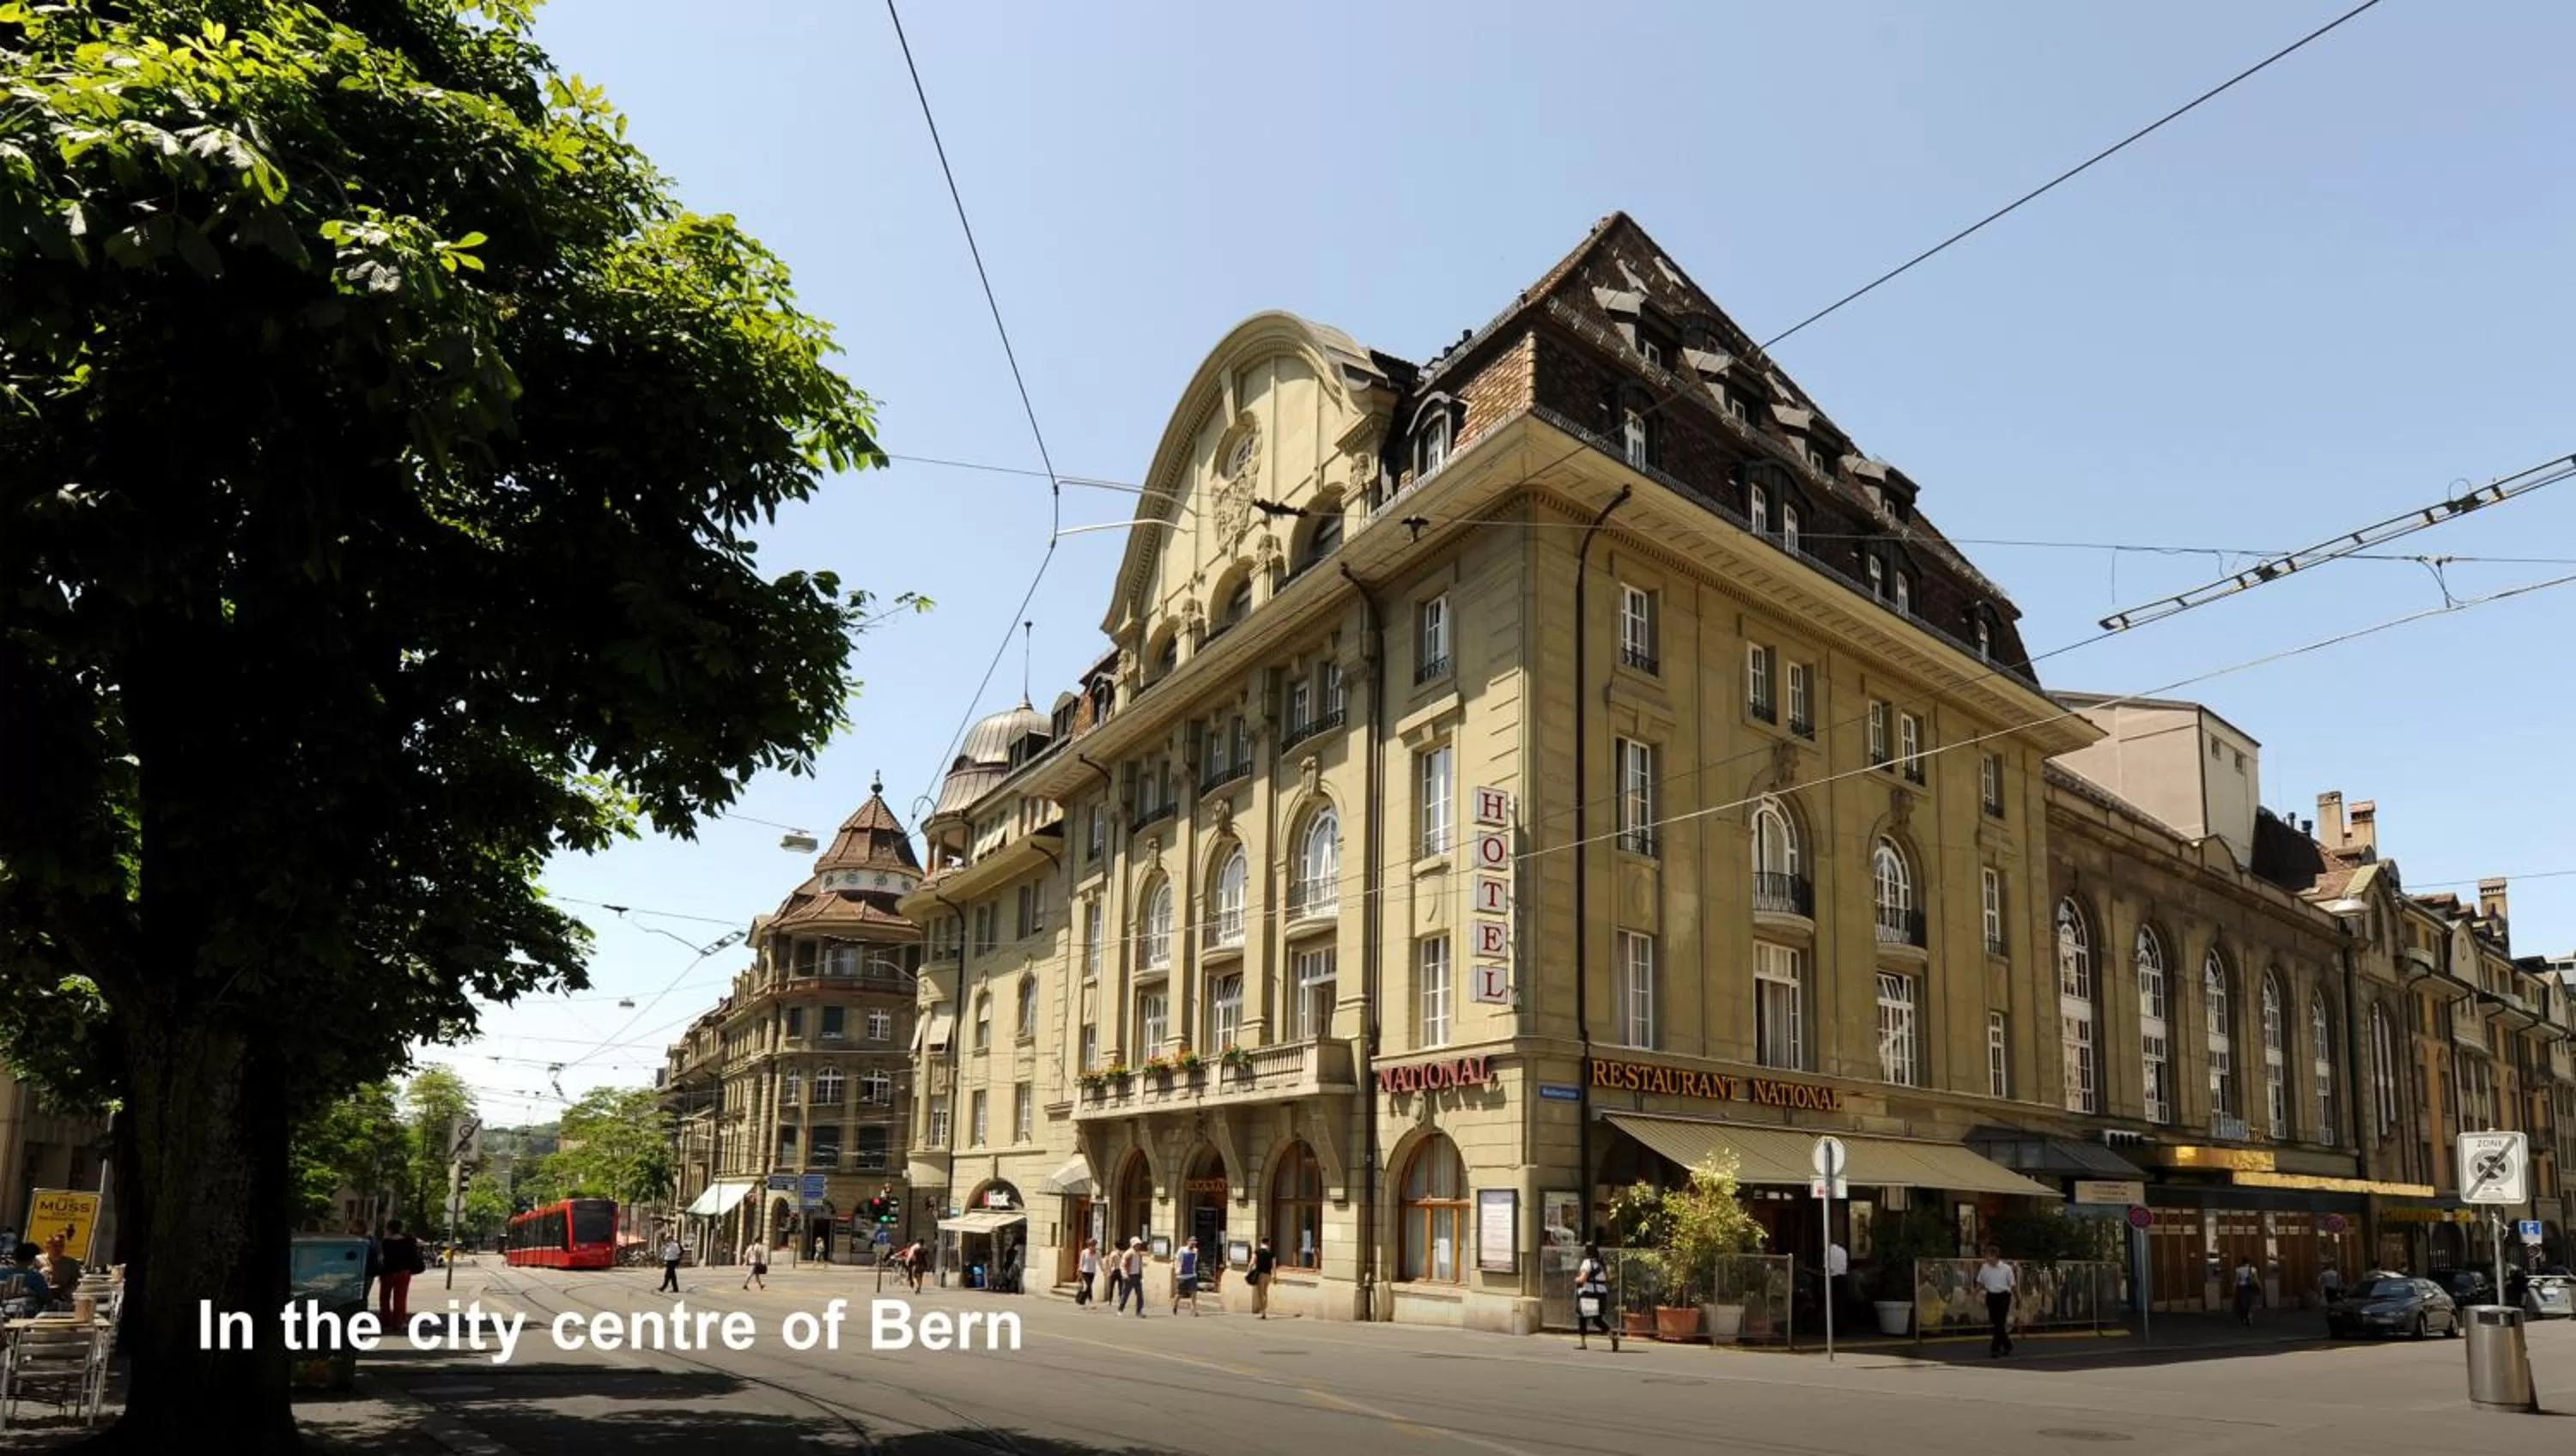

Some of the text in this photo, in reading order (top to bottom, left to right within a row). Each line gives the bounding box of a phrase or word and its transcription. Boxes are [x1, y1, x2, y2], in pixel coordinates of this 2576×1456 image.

[1481, 792, 1506, 998] HOTEL
[1378, 1055, 1492, 1093] NATIONAL
[1591, 1059, 1842, 1111] RESTAURANT NATIONAL
